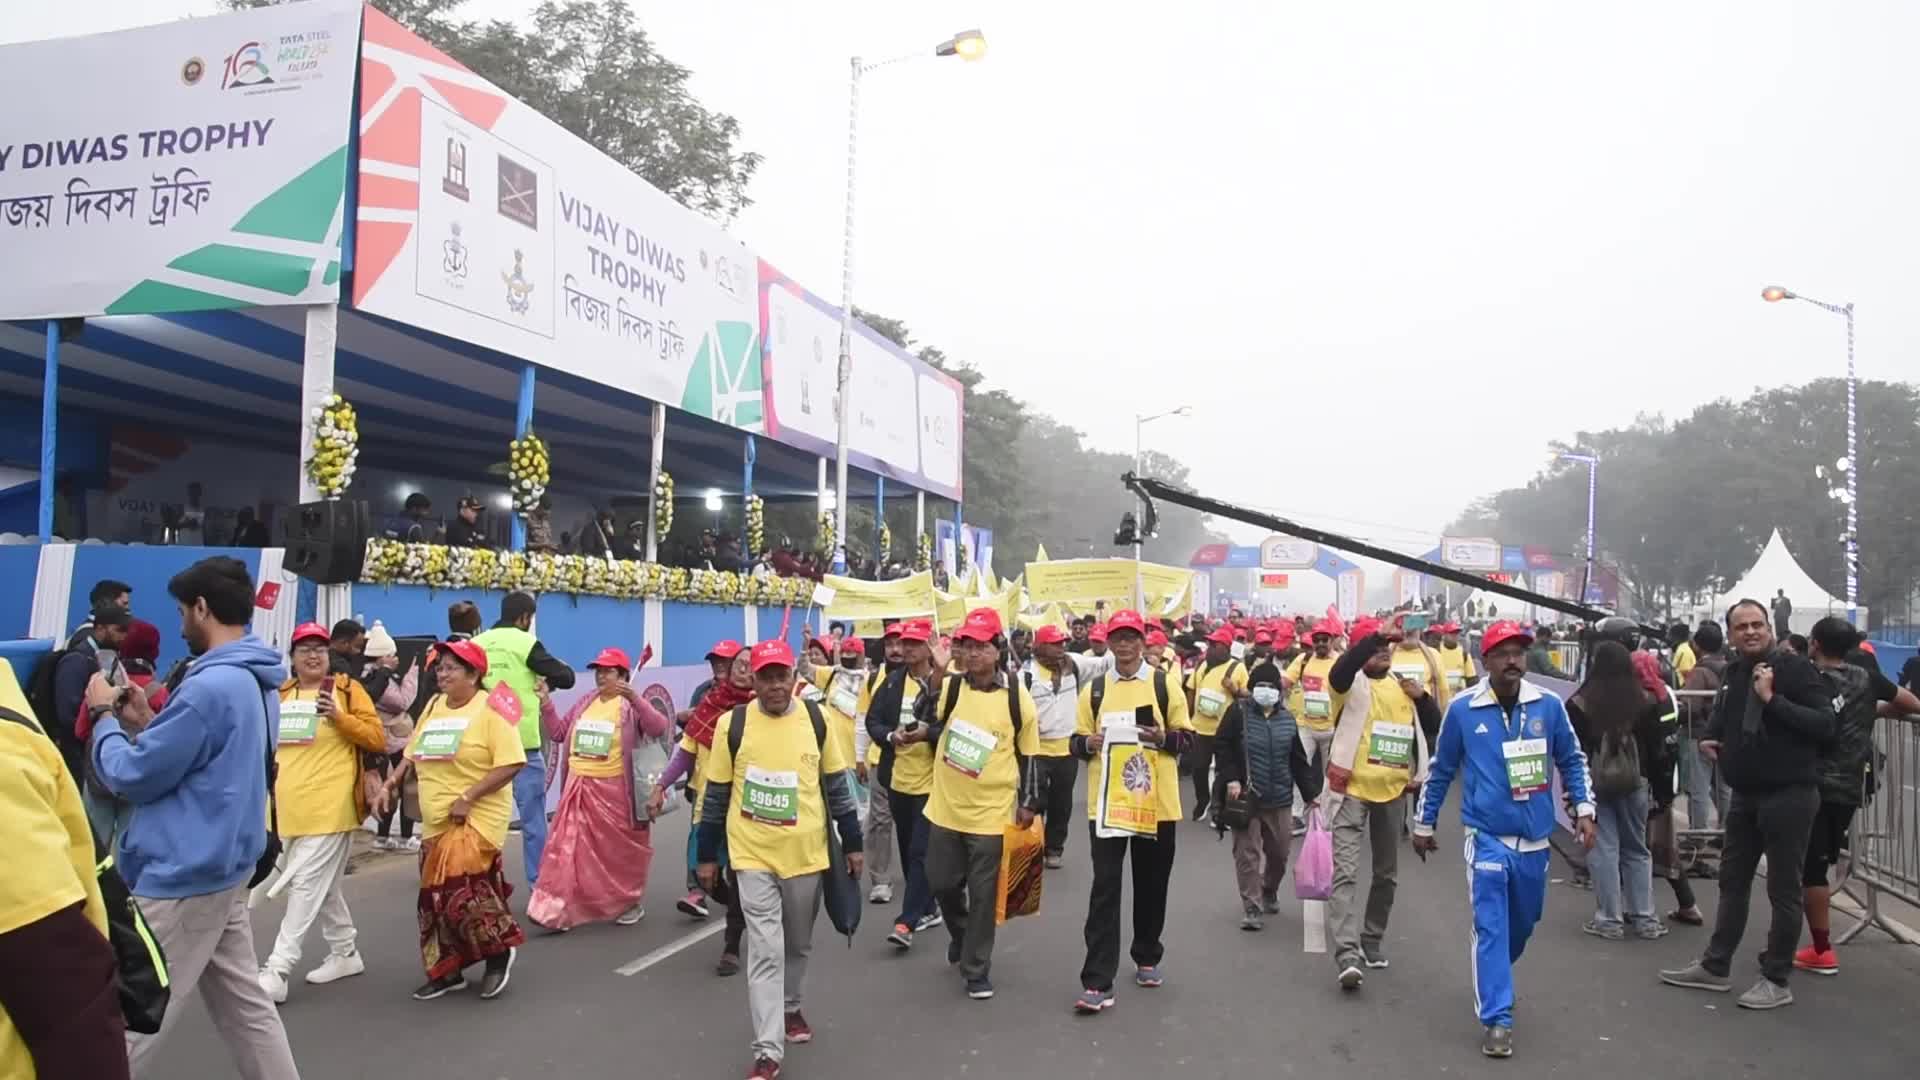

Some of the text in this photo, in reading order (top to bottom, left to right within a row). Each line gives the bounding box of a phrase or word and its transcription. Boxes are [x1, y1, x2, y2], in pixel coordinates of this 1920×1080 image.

[280, 34, 304, 44] TATA
[22, 134, 128, 169] DIWAS
[138, 118, 275, 158] TROPHY
[0, 167, 212, 227] জয় দিবস ট্রফি
[559, 191, 685, 284] VIJAY DIWAS
[587, 245, 666, 307] TROPHY
[563, 272, 610, 332] বিজয়
[616, 296, 653, 348] দিবস
